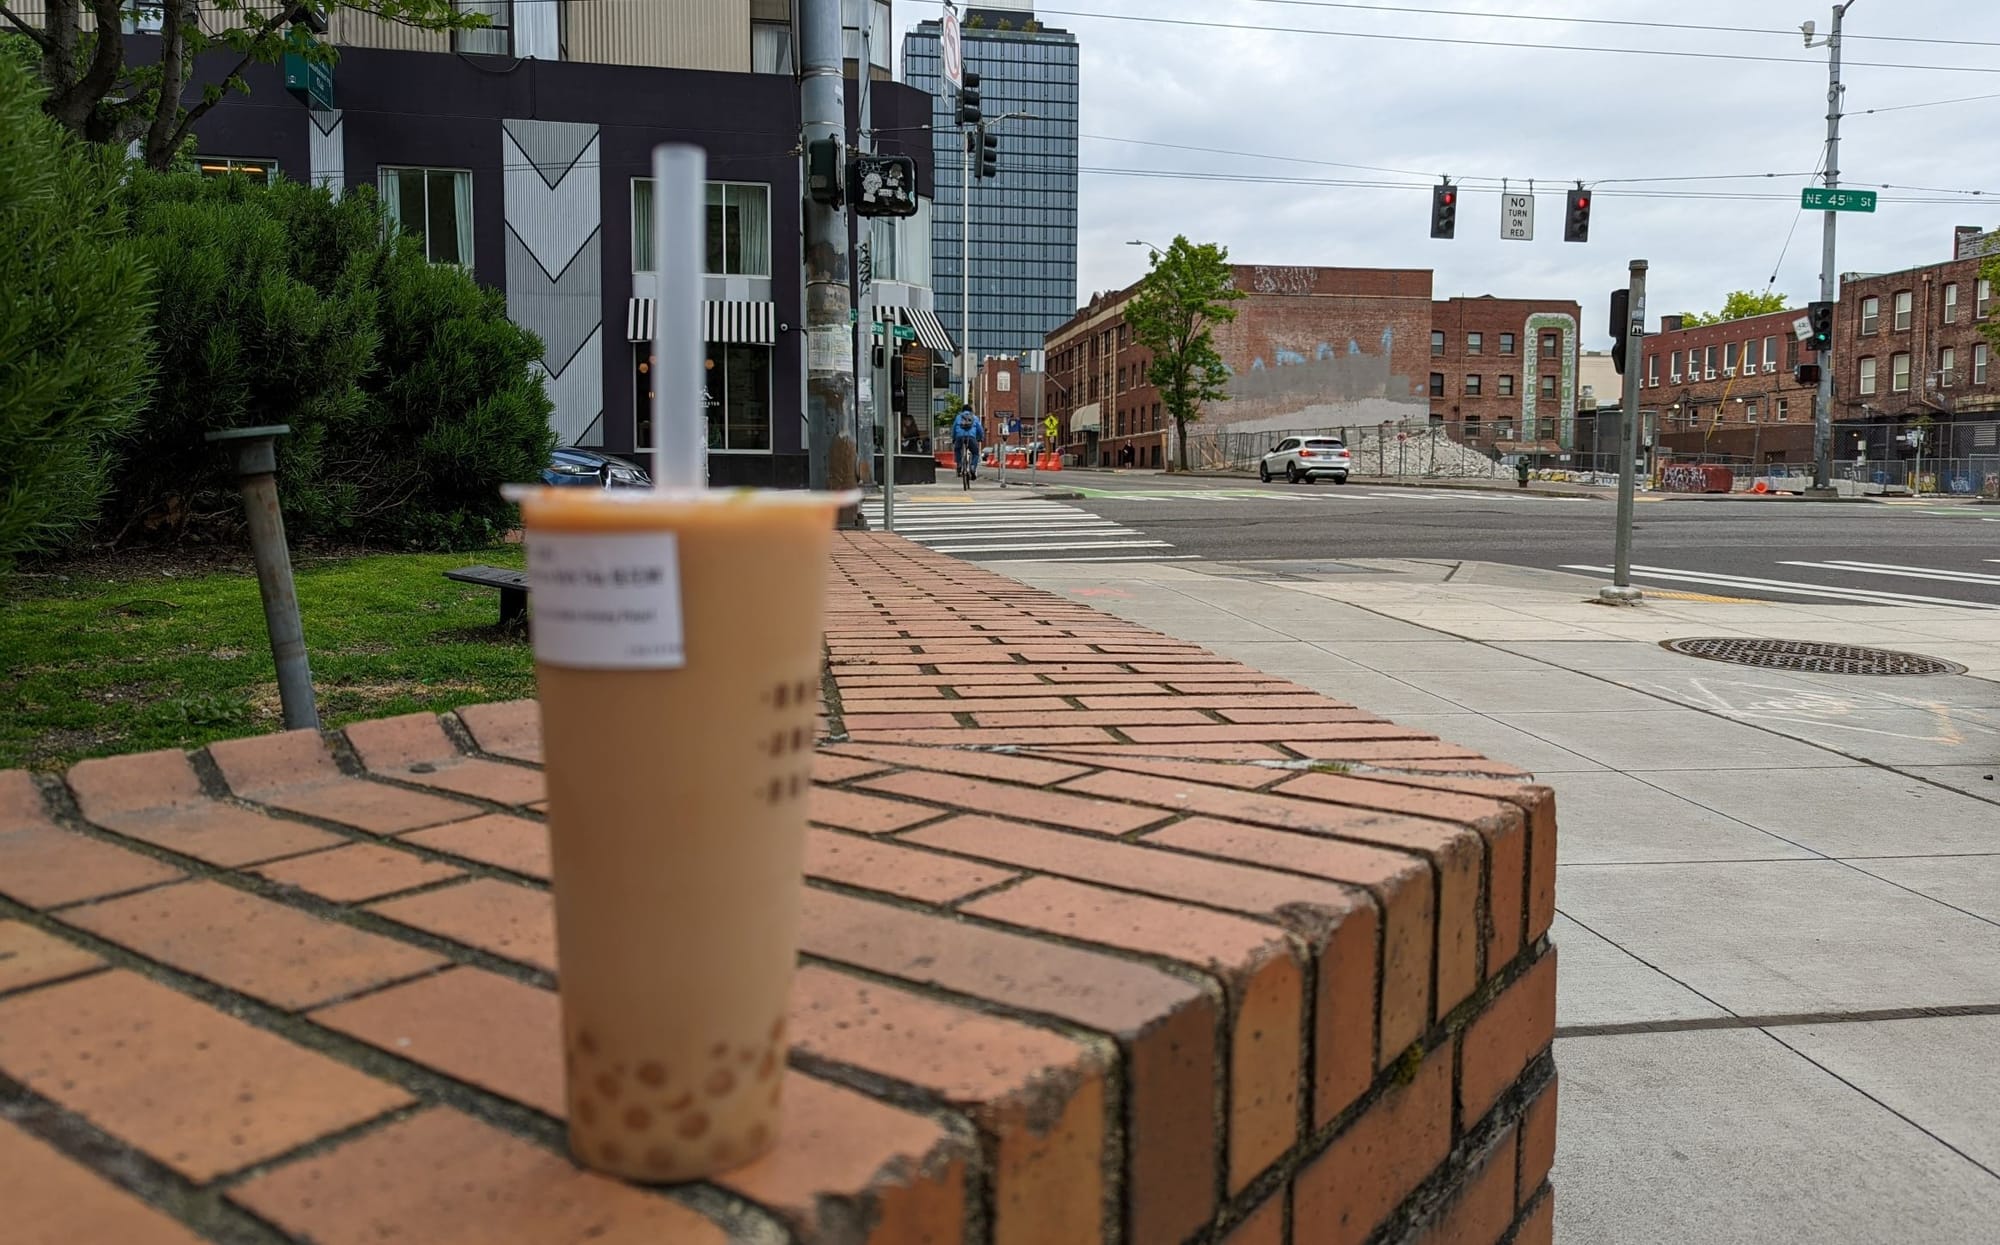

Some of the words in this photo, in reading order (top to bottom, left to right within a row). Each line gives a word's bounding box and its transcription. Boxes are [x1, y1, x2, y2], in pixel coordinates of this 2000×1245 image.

[1511, 198, 1525, 207] NO
[1806, 194, 1822, 204] NE
[1828, 195, 1853, 206] 45th
[1860, 198, 1871, 207] St
[1508, 209, 1528, 217] TURN
[1512, 219, 1523, 227] ON
[1510, 229, 1525, 237] RED
